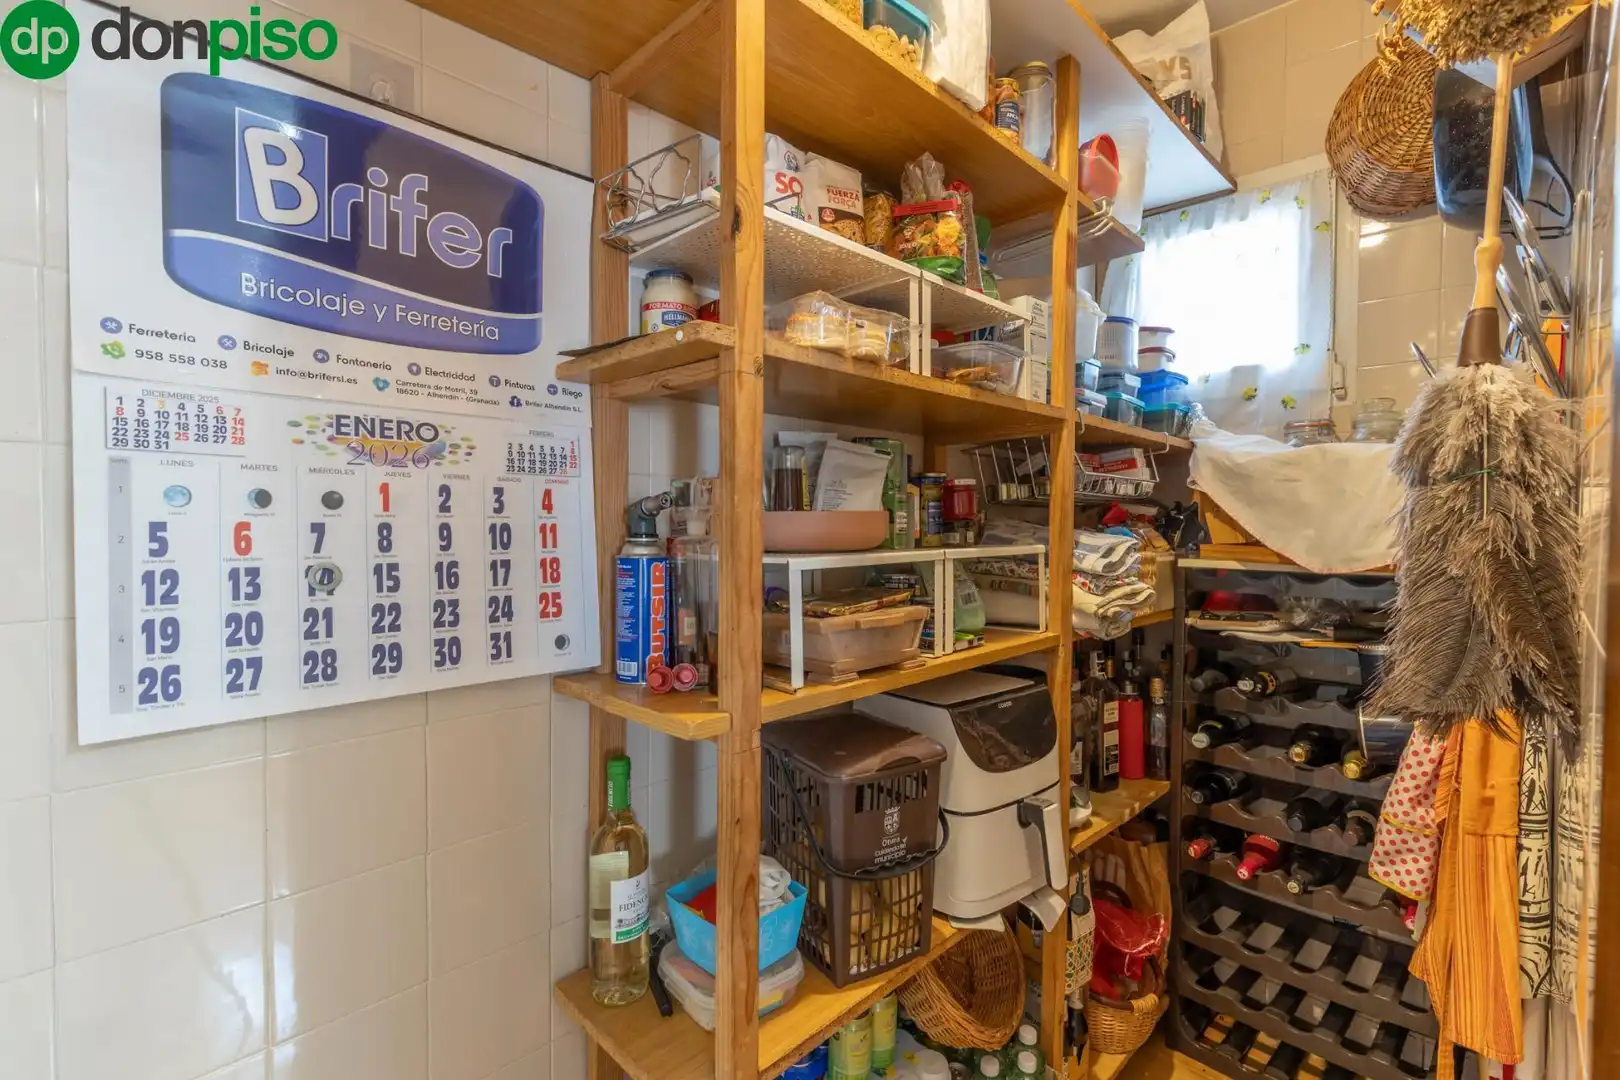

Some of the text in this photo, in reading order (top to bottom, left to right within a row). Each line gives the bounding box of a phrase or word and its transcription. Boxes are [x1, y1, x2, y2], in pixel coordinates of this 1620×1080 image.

[244, 126, 513, 278] Brifer
[826, 188, 860, 201] FUERZA
[240, 273, 499, 341] Bricolaje y Ferretería
[135, 349, 228, 370] 958 558 038
[243, 340, 295, 358] Bricolaje
[425, 367, 476, 382] Electricidad
[504, 379, 535, 391] Pinturas
[562, 387, 583, 398] Riego
[275, 367, 358, 385] info@brifersl.es
[142, 389, 220, 403] DICIEMBRE 2025
[396, 380, 431, 390] Carretera
[445, 385, 467, 395] Motril,
[396, 388, 419, 396] 18620
[466, 395, 499, 406] (Granada)
[116, 396, 123, 405] 1
[137, 399, 144, 407] 2
[178, 403, 185, 411] 4
[197, 405, 204, 413] 5
[216, 406, 223, 414] 6
[234, 408, 241, 416] 7
[112, 417, 244, 436] 15 16 17 18 19 20 21
[116, 407, 244, 426] 8 9 10 11 12 13 14
[112, 427, 245, 445] 22 23 24 25 26 27 28
[334, 414, 439, 443] ENERO
[112, 438, 169, 449] 29 30 31
[346, 441, 430, 469] 2026
[241, 464, 278, 472] MARTES
[379, 482, 390, 512] 1
[439, 484, 451, 513] 2
[493, 487, 504, 514] 3
[542, 488, 553, 514] 4
[118, 521, 557, 558] 2 5 6 7 8 9 10 11
[118, 585, 125, 593] 3
[141, 569, 179, 606] 12
[228, 567, 261, 601] 13
[373, 563, 400, 593] 15
[435, 561, 459, 590] 16
[490, 559, 511, 587] 17
[539, 557, 561, 584] 18
[118, 592, 563, 655] 4 19 20 21 22 23 24 25
[118, 631, 512, 705] 5 26 27 28 29 30 31
